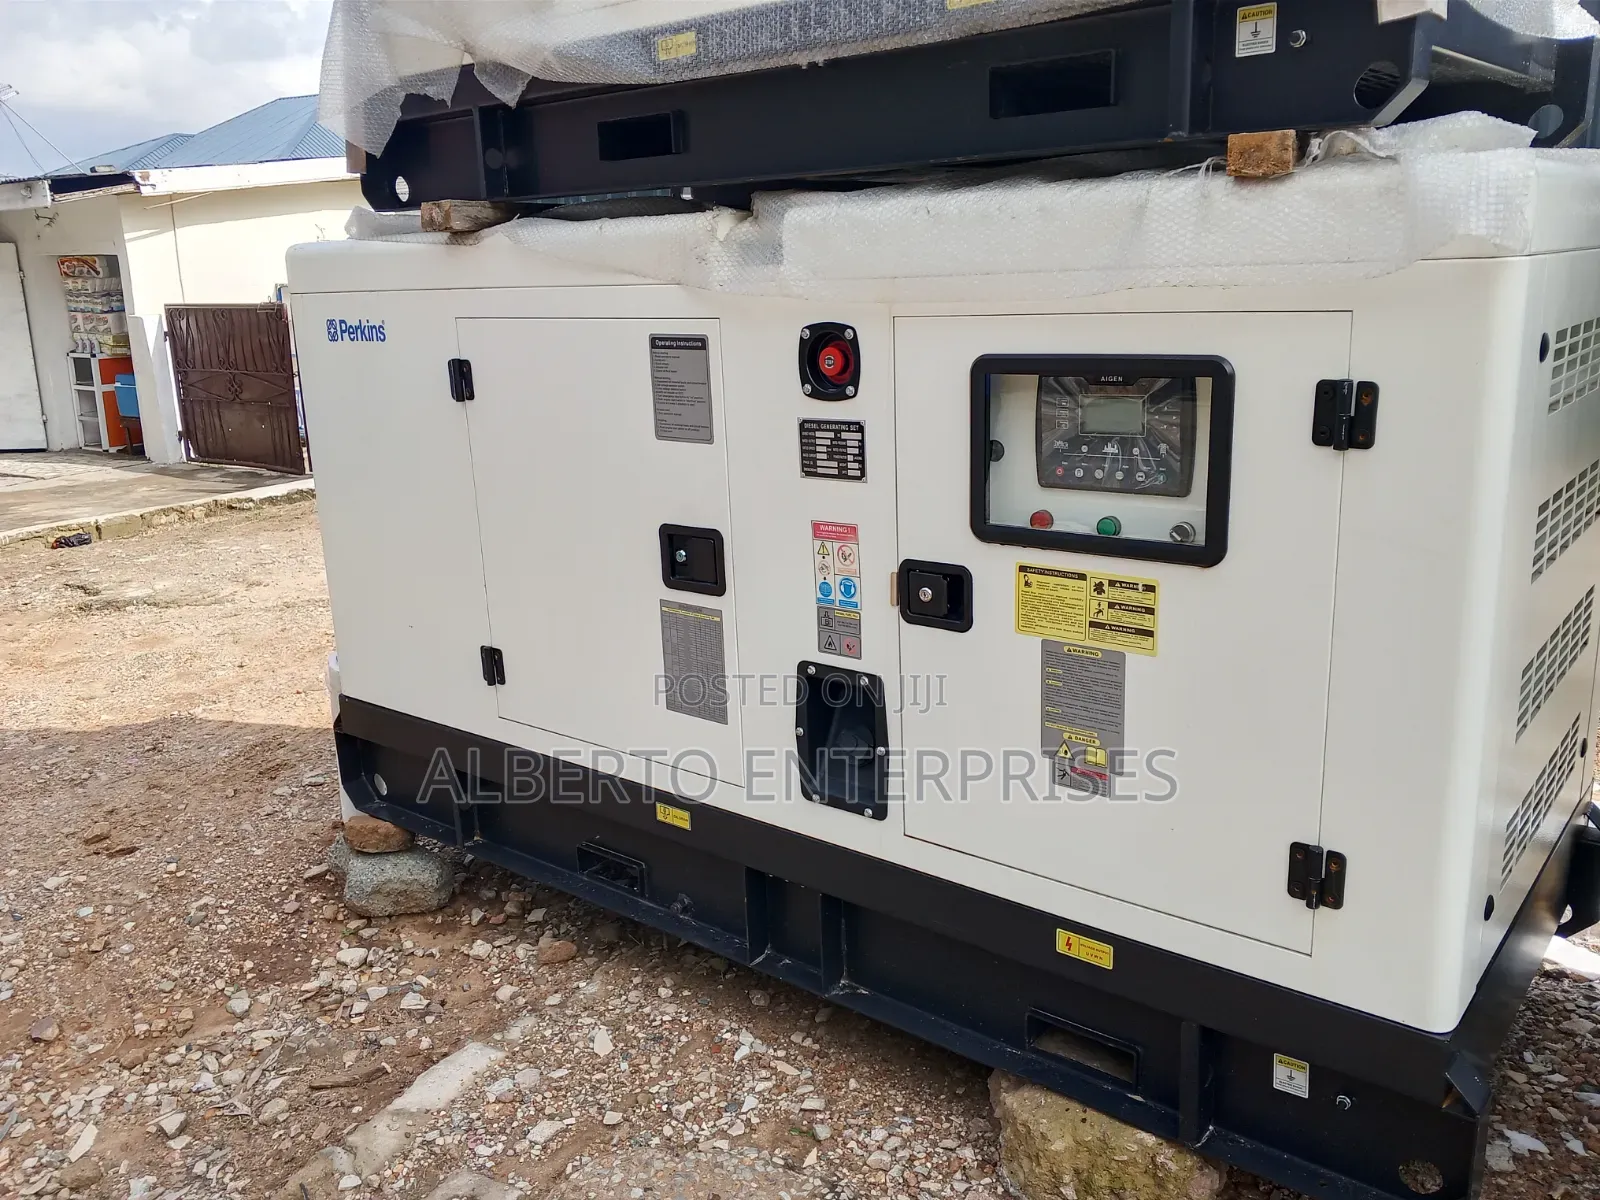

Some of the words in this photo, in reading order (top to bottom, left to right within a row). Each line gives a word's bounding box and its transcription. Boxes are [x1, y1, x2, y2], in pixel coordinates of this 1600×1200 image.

[1248, 9, 1273, 18] CAUTION
[339, 319, 386, 342] Perkins
[820, 423, 849, 431] GENERATING
[1044, 570, 1079, 579] INSTRUCTIONS
[1120, 604, 1146, 613] WARNING
[1110, 625, 1136, 633] WARNING
[1072, 647, 1099, 657] WARNING
[1074, 735, 1097, 744] DANGER
[1284, 1060, 1306, 1071] CAUTION
